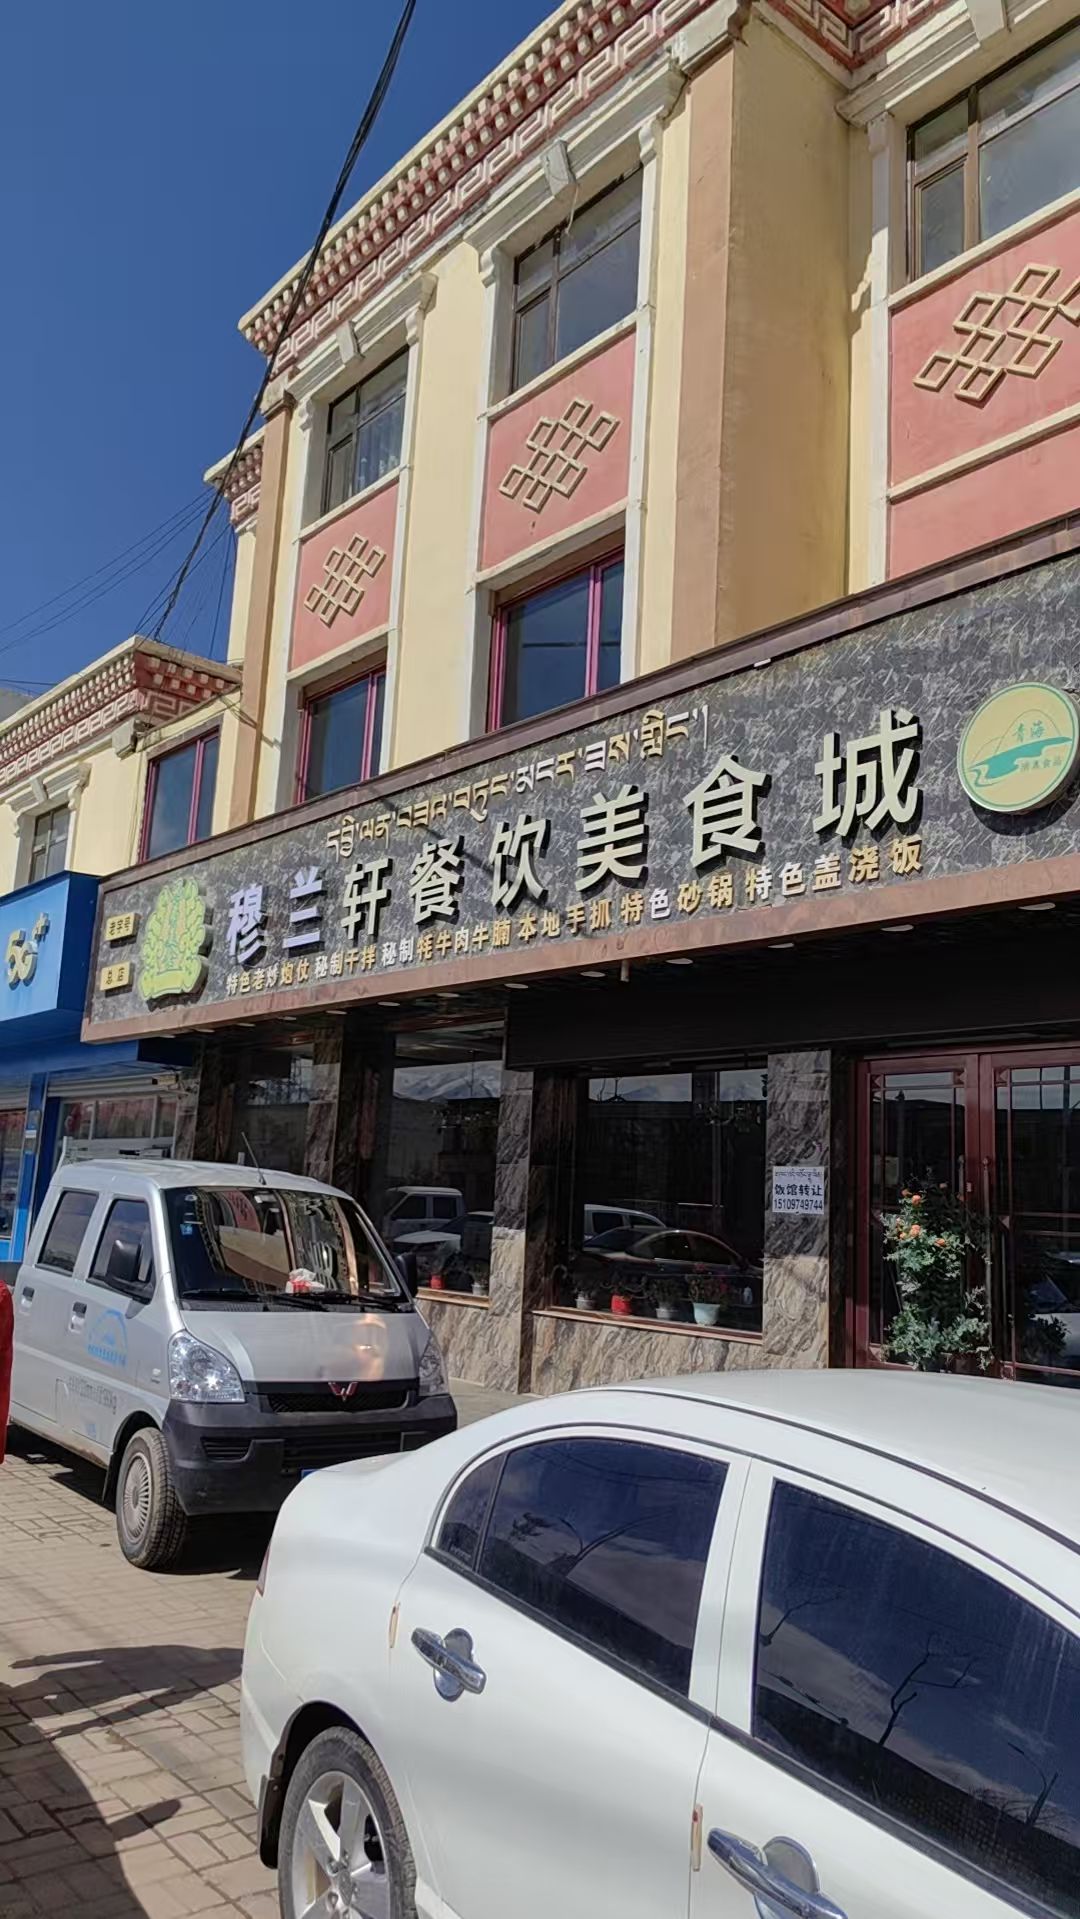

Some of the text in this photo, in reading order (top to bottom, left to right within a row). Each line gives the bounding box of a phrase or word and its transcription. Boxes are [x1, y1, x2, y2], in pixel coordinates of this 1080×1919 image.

[225, 710, 917, 963] 穆兰轩餐饮美食城
[313, 944, 377, 980] 秘制干拌
[517, 898, 613, 943] 本地手抓
[621, 873, 733, 924] 特色砂锅
[745, 834, 923, 902] 特色盖浇饭
[774, 1199, 822, 1210] 15109749744
[775, 1184, 822, 1196] 饭馆转让
